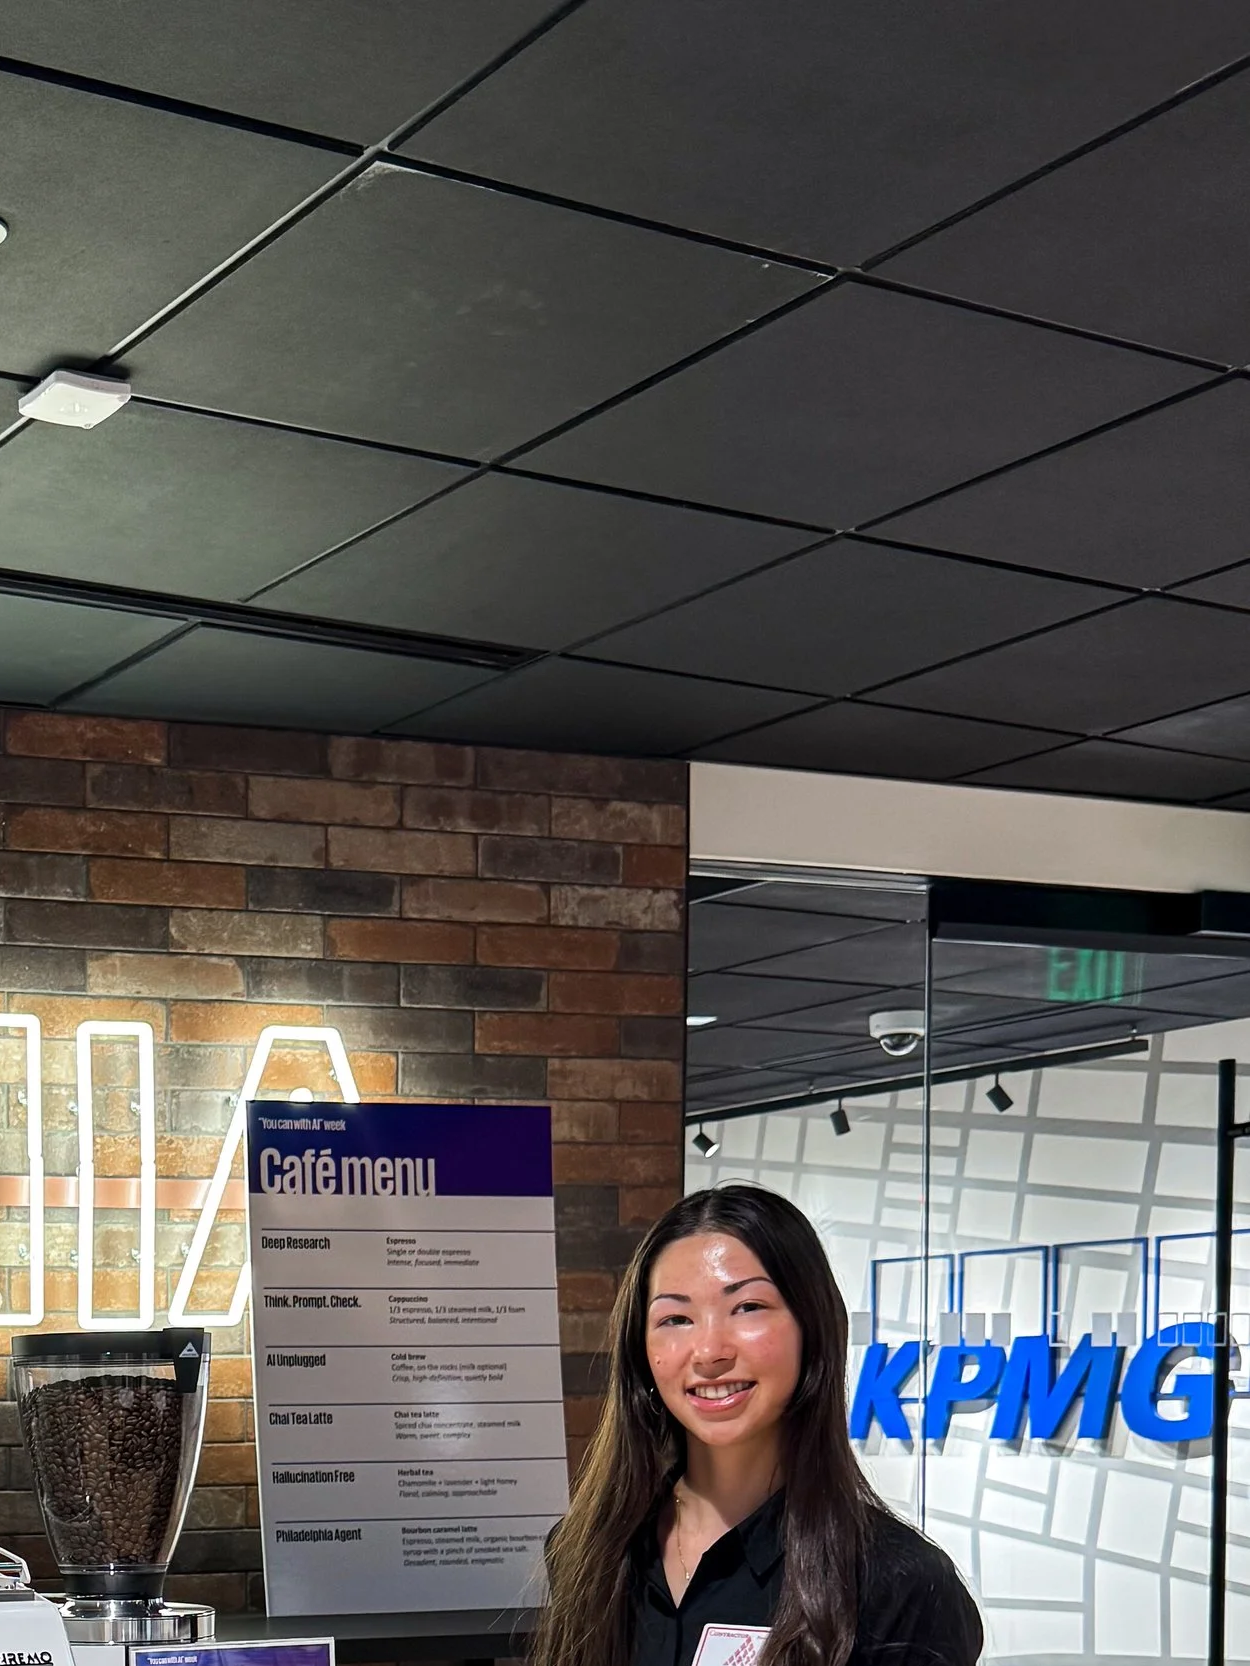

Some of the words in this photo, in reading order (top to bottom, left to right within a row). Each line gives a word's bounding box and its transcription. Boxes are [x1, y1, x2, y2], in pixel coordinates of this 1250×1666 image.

[278, 1119, 293, 1131] can
[293, 1118, 312, 1131] with
[324, 1119, 347, 1132] week
[259, 1147, 337, 1196] Café
[340, 1156, 437, 1197] menu
[261, 1236, 286, 1251] Deep
[286, 1236, 331, 1251] Research
[386, 1237, 417, 1246] Espresso
[386, 1248, 407, 1257] Single
[441, 1249, 472, 1257] espresso
[264, 1294, 292, 1309] Think.
[292, 1294, 330, 1310] Prompt.
[330, 1294, 362, 1309] Check.
[388, 1295, 429, 1304] Cappuccino
[389, 1306, 402, 1314] 1/3
[435, 1306, 447, 1314] 1/3
[496, 1306, 507, 1314] 1/3
[266, 1354, 276, 1368] AI
[276, 1354, 327, 1369] Unplugged
[390, 1353, 407, 1361] Cold
[408, 1353, 427, 1361] brew
[427, 1363, 439, 1371] the
[850, 1321, 1220, 1443] KPMG
[269, 1412, 290, 1426] Chai
[290, 1412, 308, 1426] Tea
[308, 1412, 334, 1425] Latte
[394, 1411, 410, 1419] Chai
[422, 1410, 440, 1418] latte
[272, 1470, 334, 1485] Hallucination
[334, 1470, 355, 1483] Free
[398, 1468, 421, 1477] Herbal
[276, 1529, 334, 1544] Philadelphia
[334, 1528, 362, 1543] Agent
[402, 1526, 432, 1535] Bourbon
[432, 1526, 461, 1534] caramel
